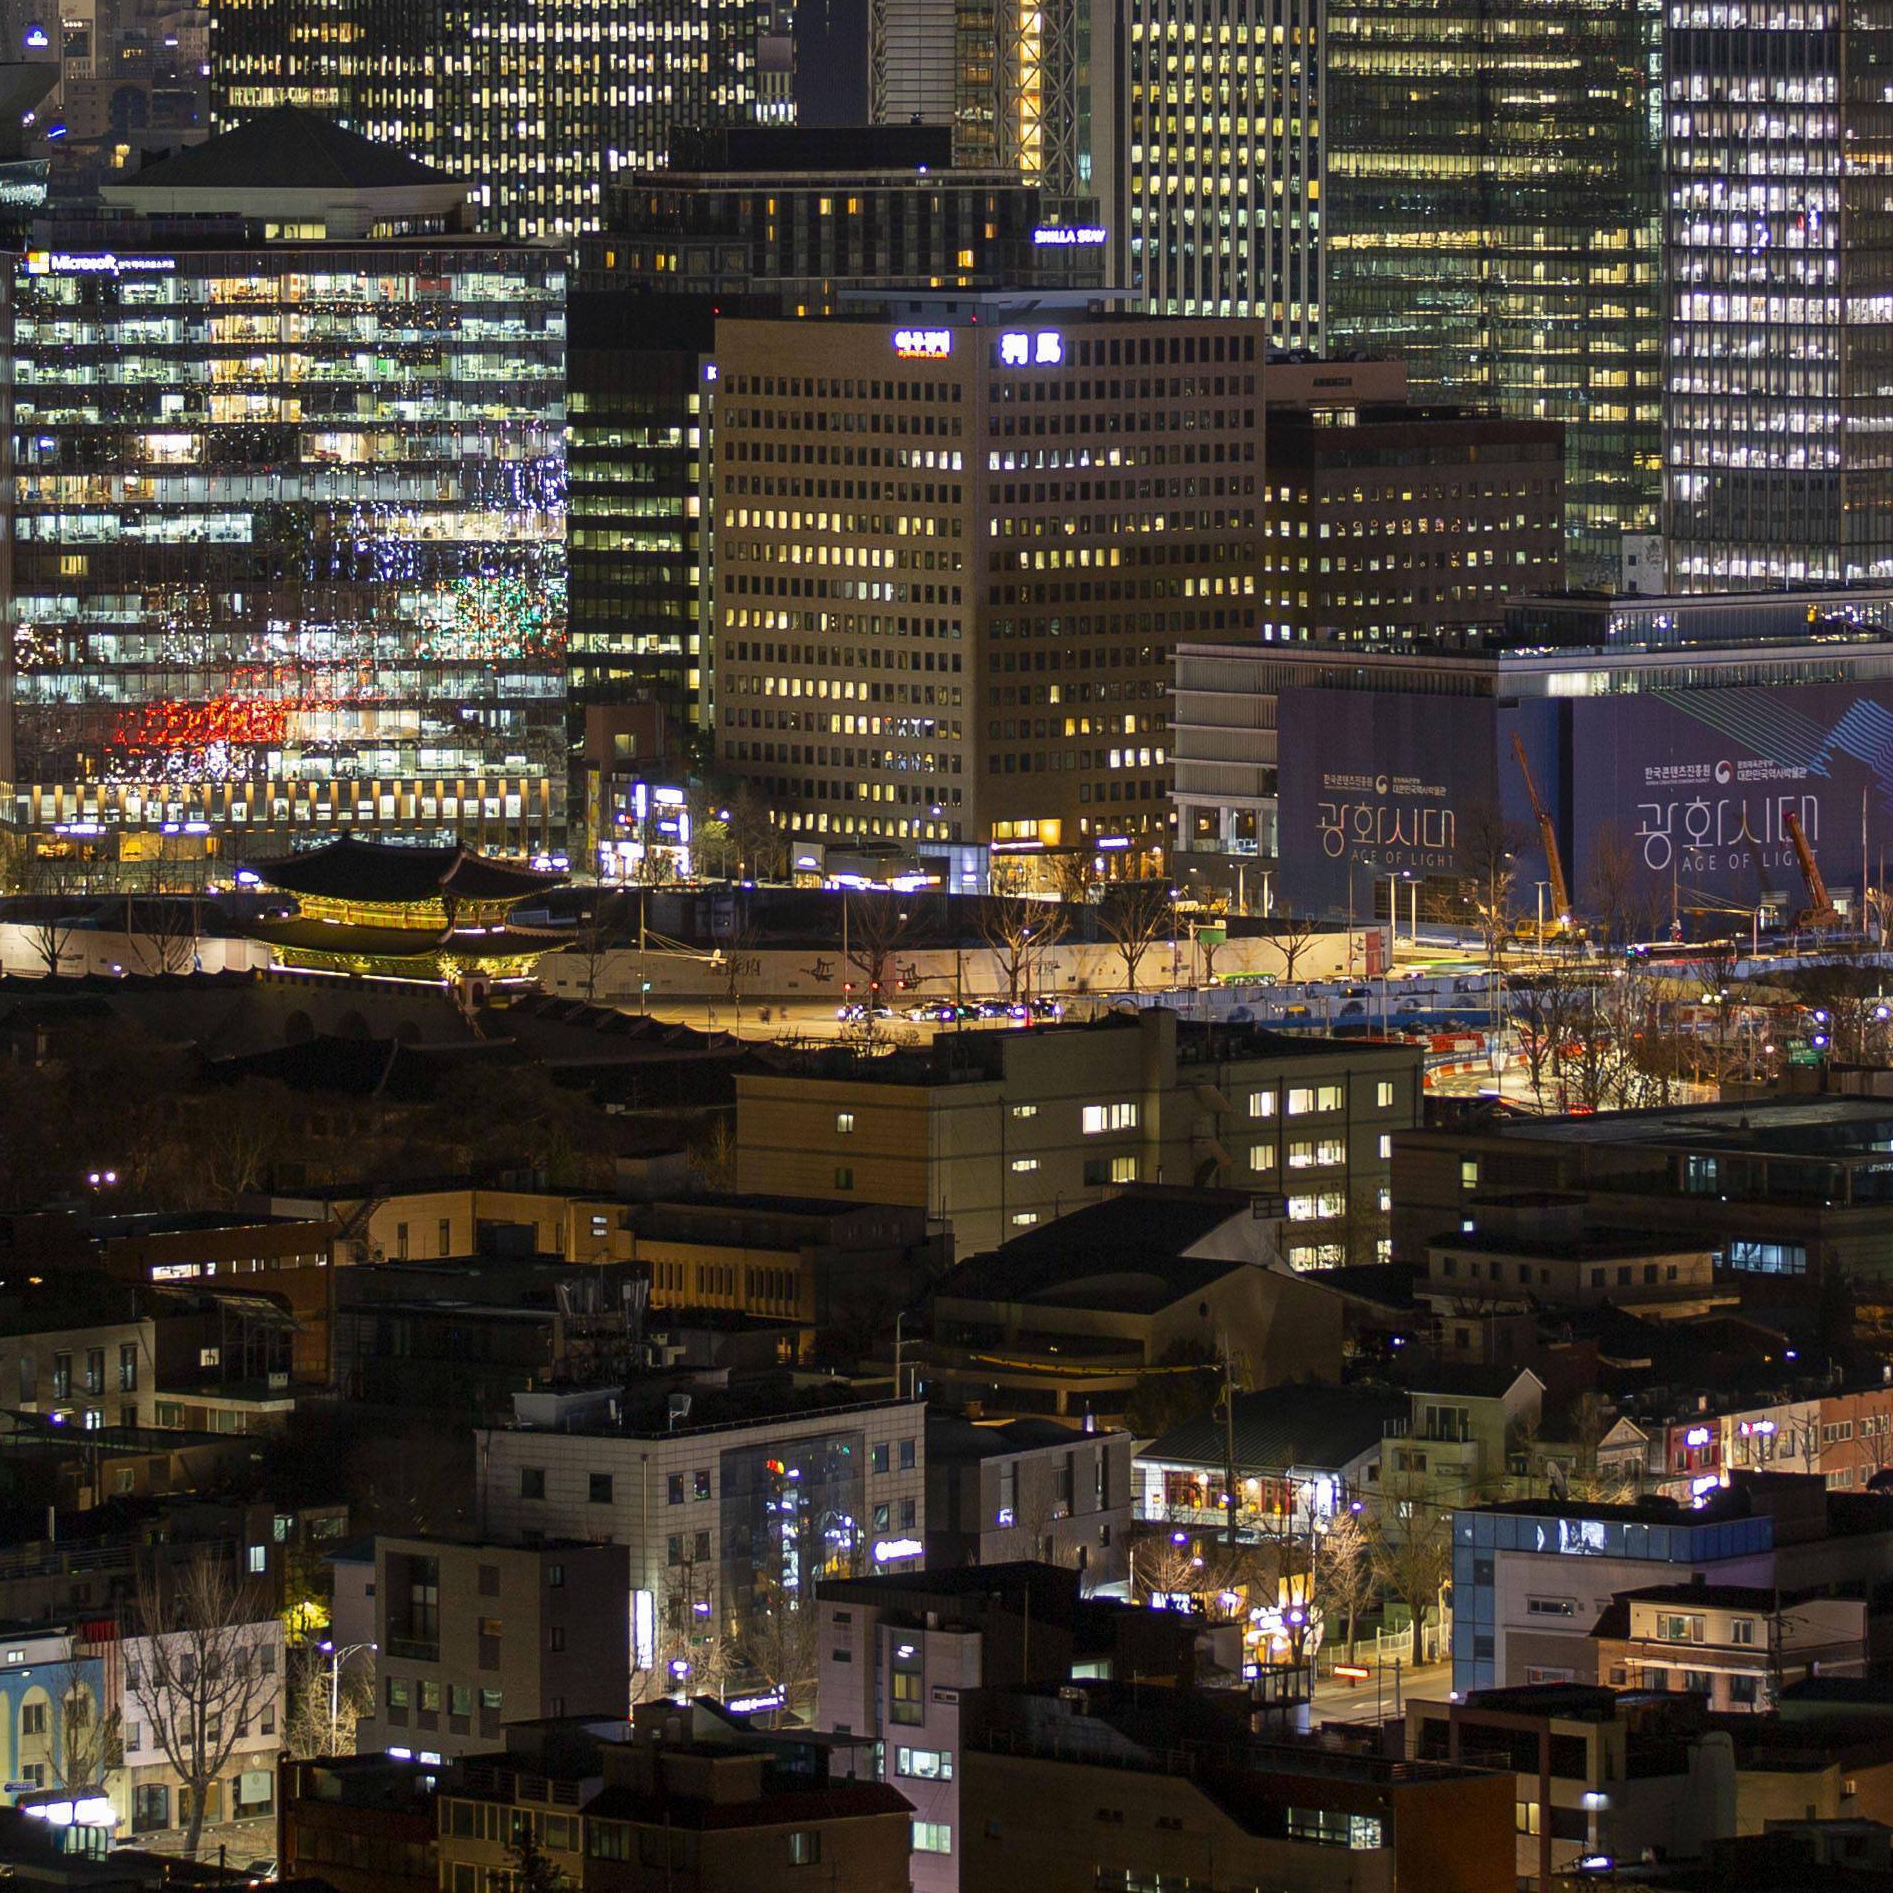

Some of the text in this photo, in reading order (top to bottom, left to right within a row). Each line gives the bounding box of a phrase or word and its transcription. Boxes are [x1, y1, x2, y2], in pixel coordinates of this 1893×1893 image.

[1034, 229, 1106, 243] SHILLA STAY
[51, 254, 117, 270] Microsoft
[1644, 763, 1711, 780] 한국콘텐츠진흥원
[1736, 766, 1808, 782] 대한민국역사박물관
[1315, 801, 1455, 858] 광화시대
[1634, 795, 1818, 870] 광화시대
[1351, 849, 1455, 868] AGE OF LIGHT
[1681, 849, 1818, 872] AGE OF LIGT
